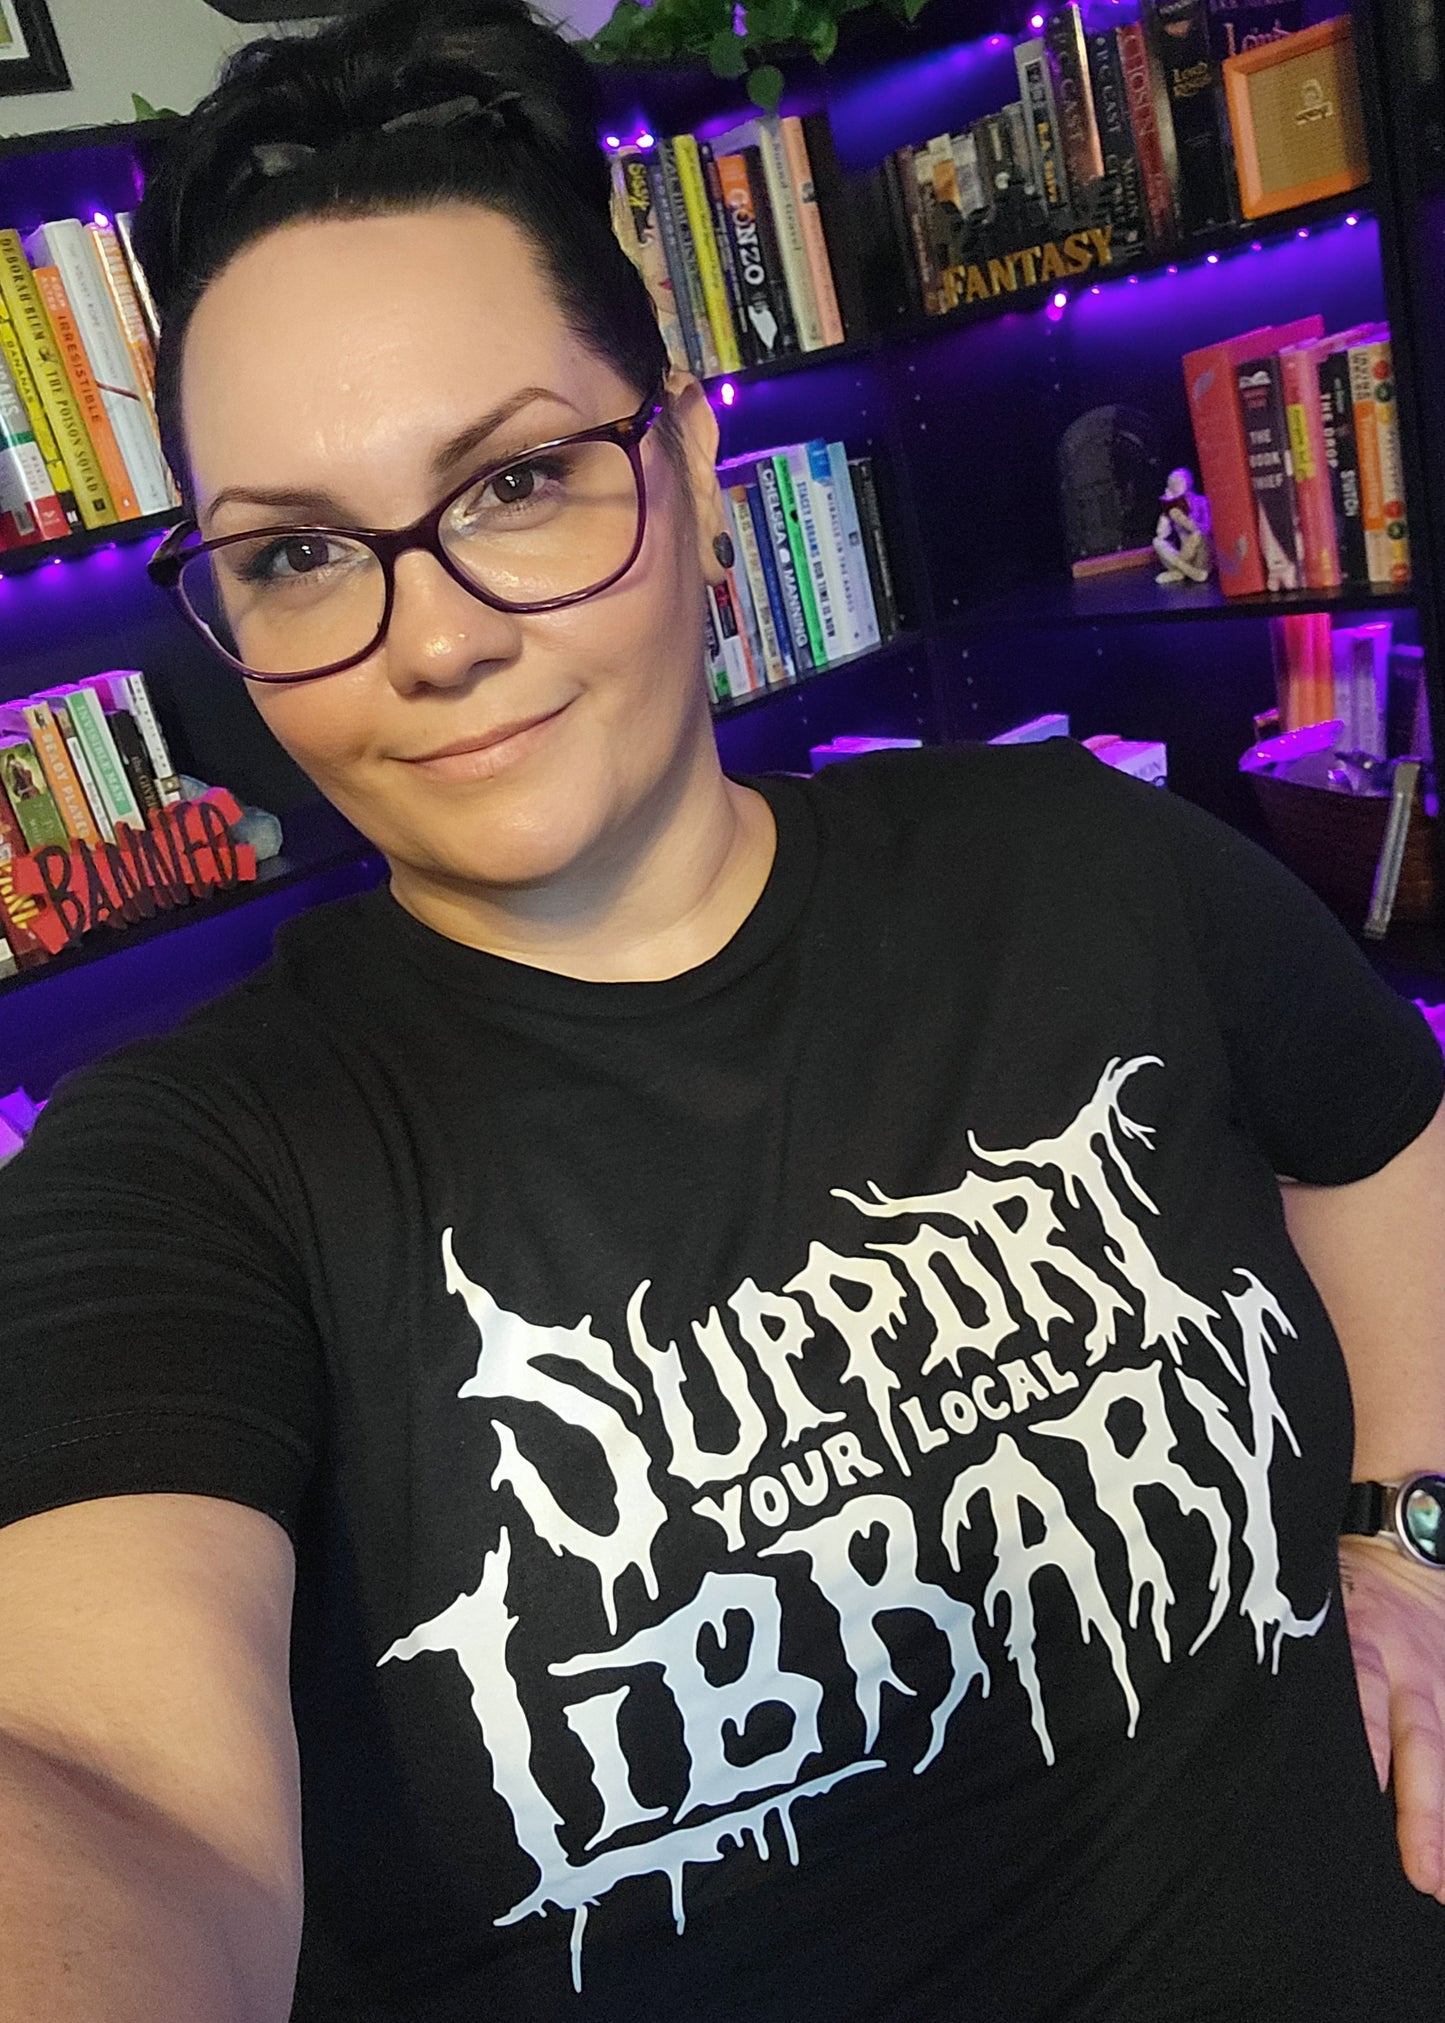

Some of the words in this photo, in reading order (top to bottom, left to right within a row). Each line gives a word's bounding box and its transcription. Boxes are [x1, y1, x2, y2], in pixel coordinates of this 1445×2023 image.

[727, 186, 766, 287] GONZO
[941, 224, 1113, 311] FANTASY
[0, 237, 33, 302] DEBORAH
[23, 305, 47, 341] BLUM
[46, 369, 65, 395] THE
[56, 398, 83, 447] POISON
[73, 449, 100, 493] SQUAD
[6, 339, 35, 404] BANANAS
[56, 314, 101, 423] IRRESISTIBLE
[762, 468, 788, 544] CHELSEA
[782, 568, 809, 647] MANNING
[816, 581, 829, 603] TIME
[824, 617, 836, 637] NOW
[76, 704, 112, 771] INVISIBLE
[105, 772, 124, 802] MAN
[34, 801, 239, 947] BANNED
[442, 1055, 1245, 1634] SUPPORT
[693, 1430, 882, 1552] YOUR
[900, 1349, 1079, 1453] LOCAL
[377, 1267, 1331, 1993] LIBRARY
